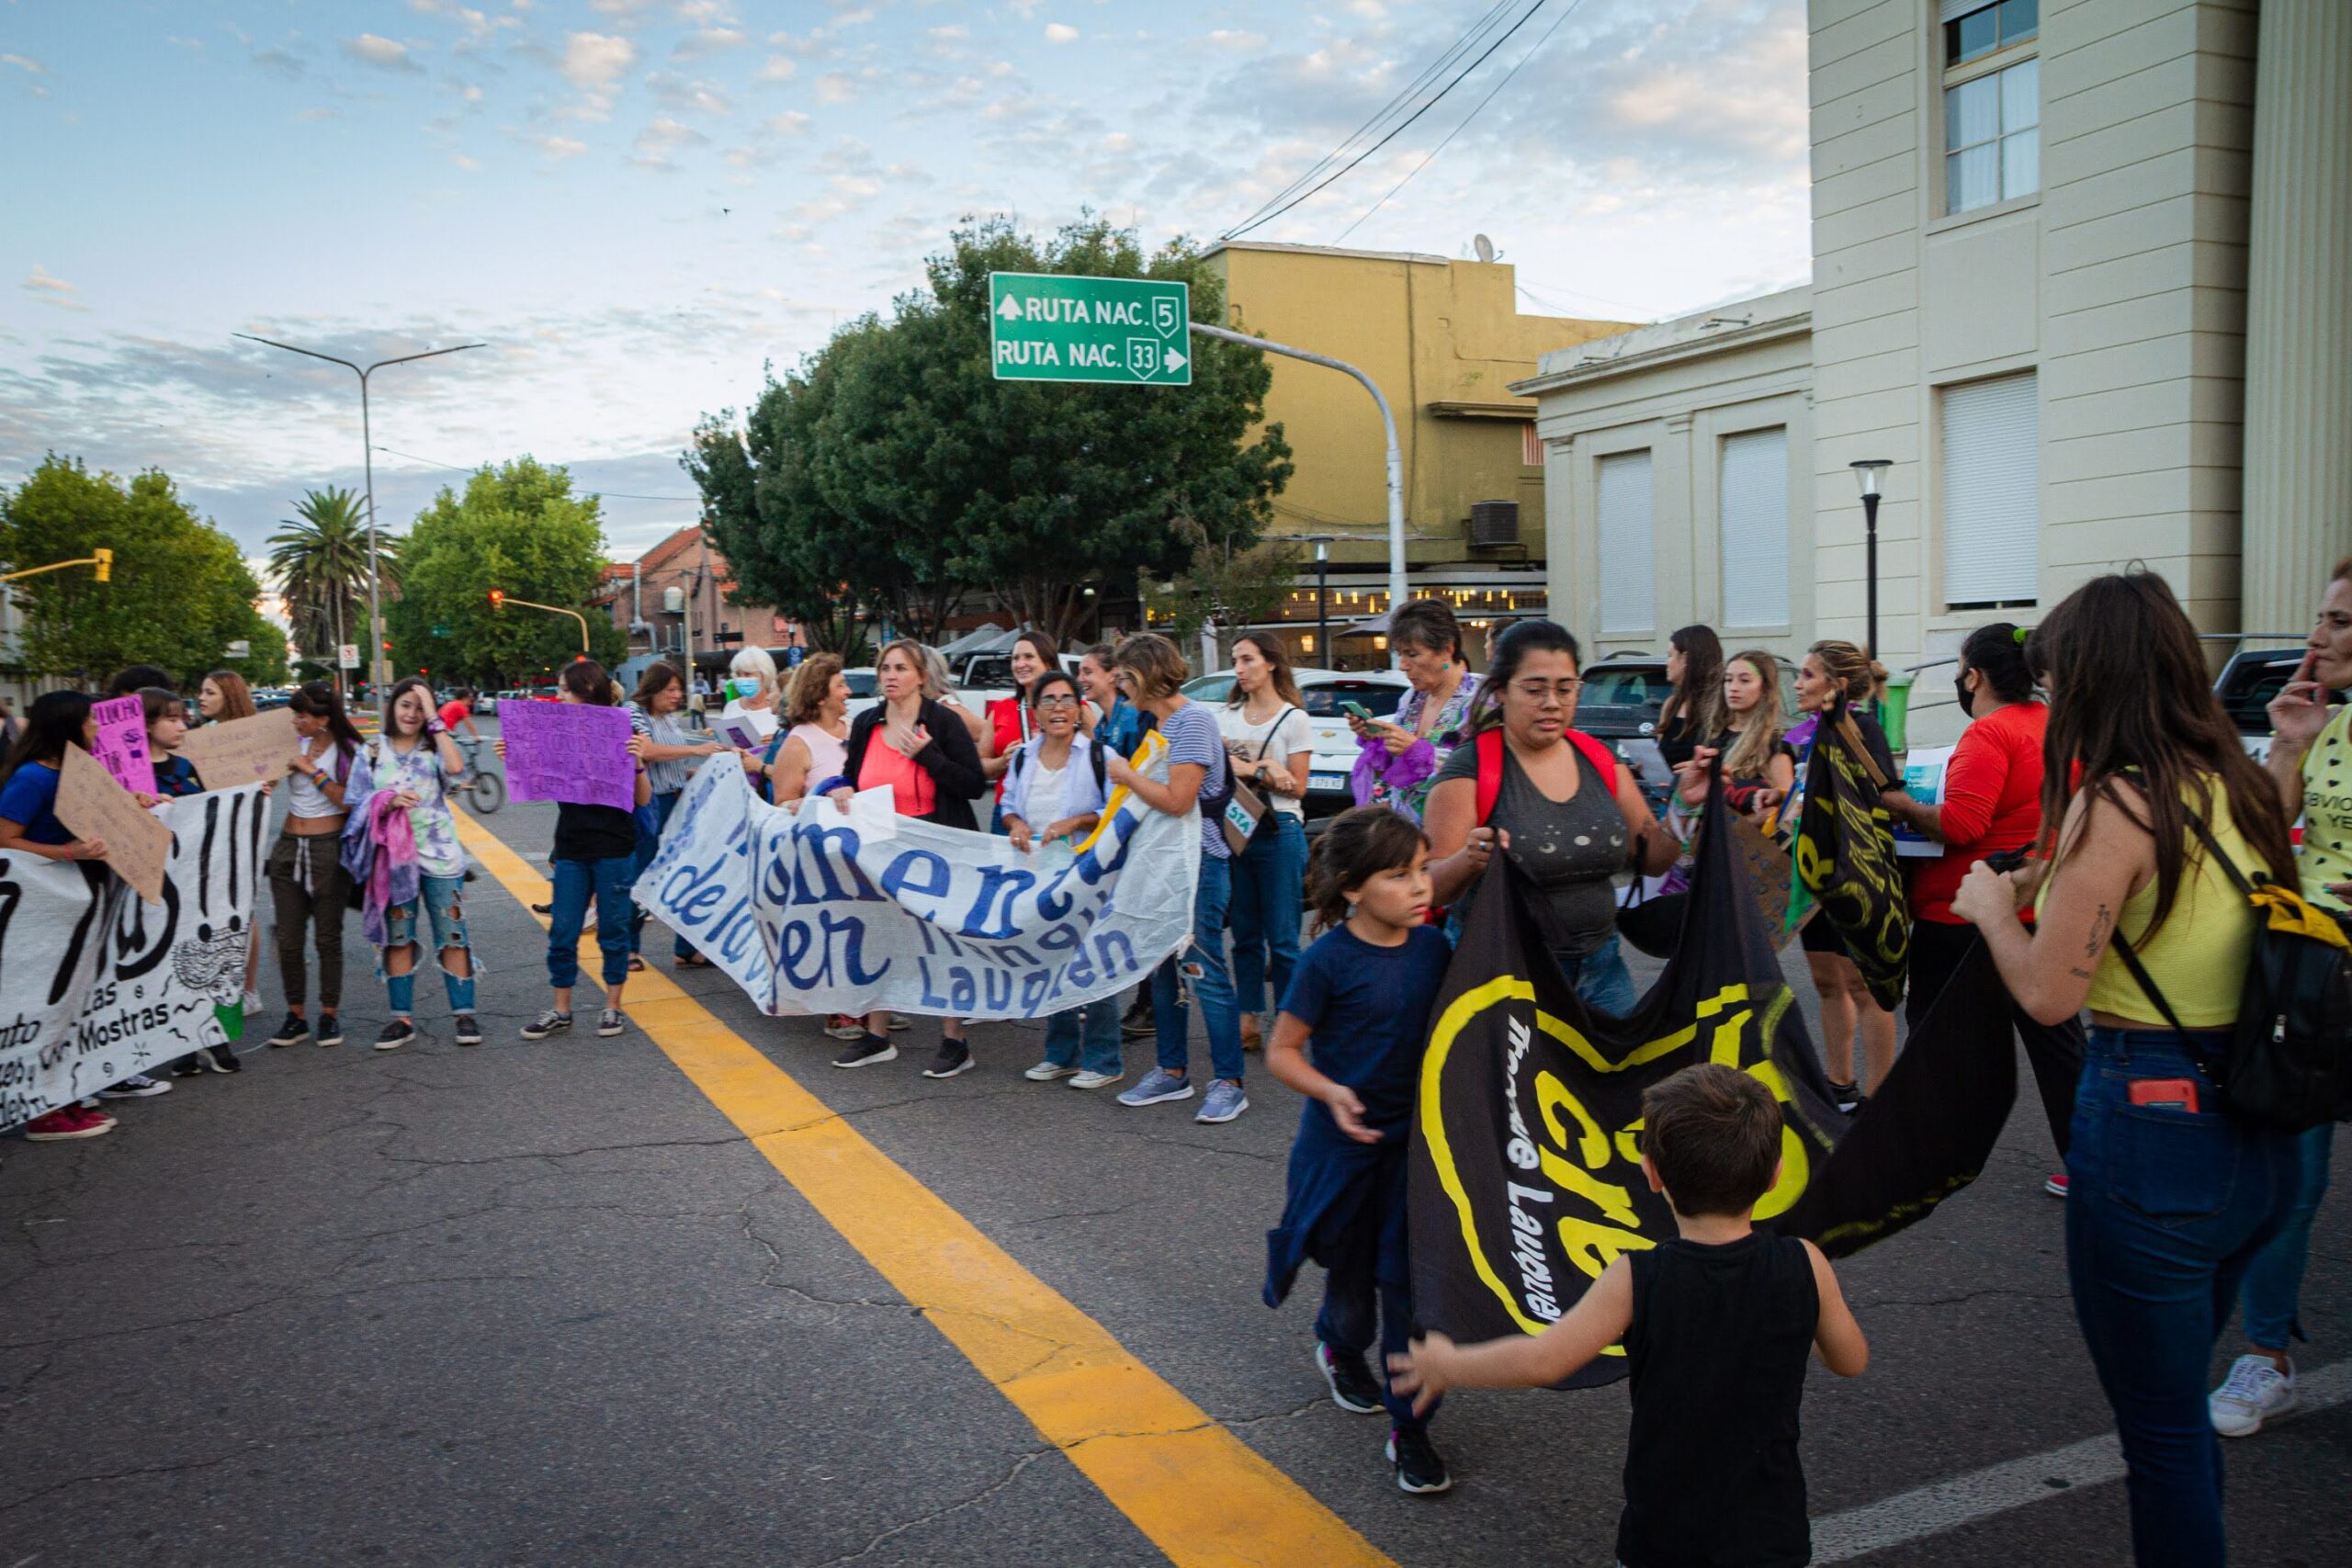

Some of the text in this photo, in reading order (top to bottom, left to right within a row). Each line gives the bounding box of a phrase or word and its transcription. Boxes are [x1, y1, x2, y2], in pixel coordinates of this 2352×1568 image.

[1025, 297, 1174, 327] RUTA NAC. 5
[996, 340, 1154, 368] RUTA NAC. 33
[77, 1001, 169, 1055] Mostras
